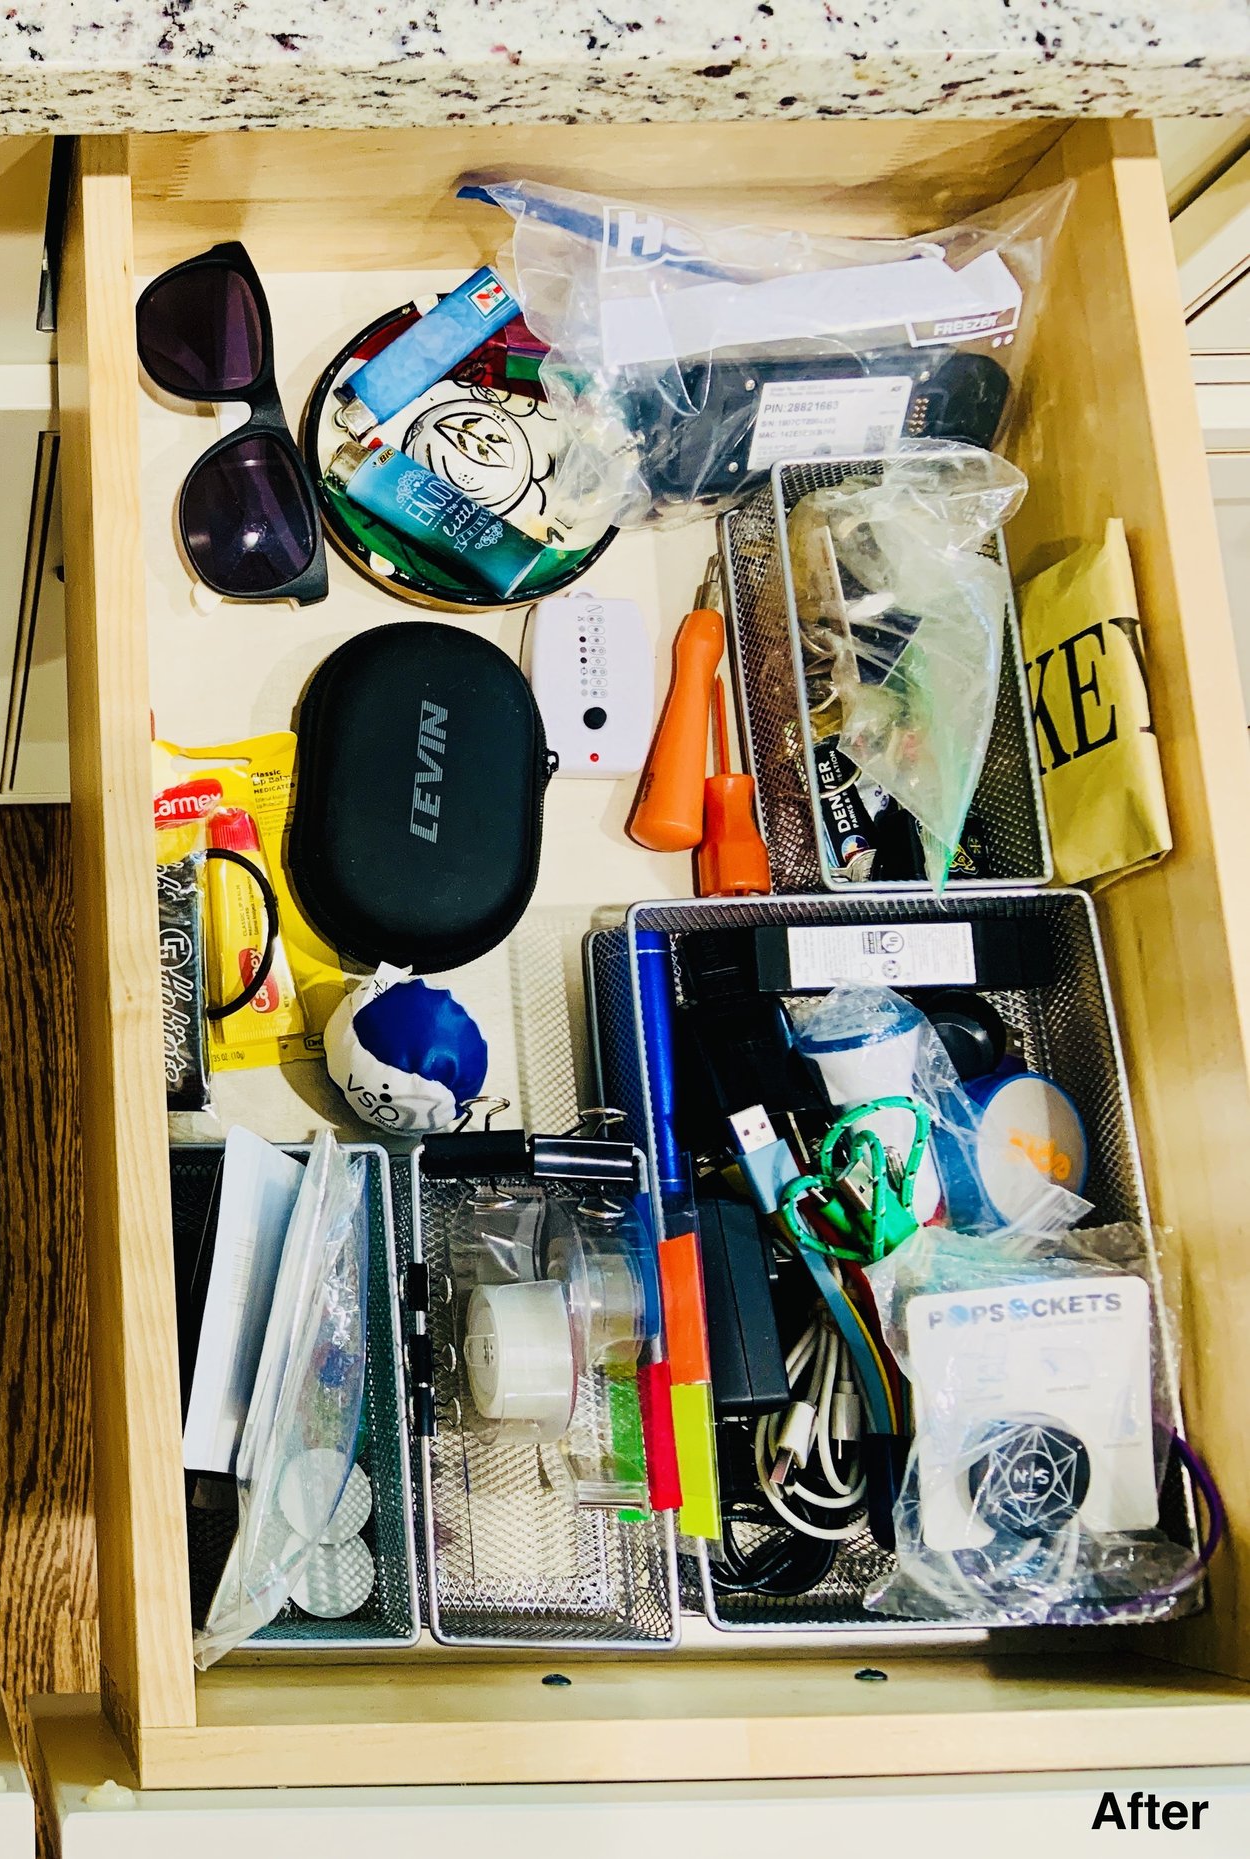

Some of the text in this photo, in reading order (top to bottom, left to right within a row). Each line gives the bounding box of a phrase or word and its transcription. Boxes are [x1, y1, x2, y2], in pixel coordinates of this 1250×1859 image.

[934, 315, 998, 337] FREEZER
[379, 447, 395, 465] BIC
[405, 479, 457, 527] ENJOY
[445, 503, 458, 515] the
[442, 502, 480, 538] little
[410, 700, 448, 844] LEVIN
[254, 782, 296, 795] MEDICATED
[846, 804, 860, 829] PARKS
[346, 1073, 400, 1123] vsp
